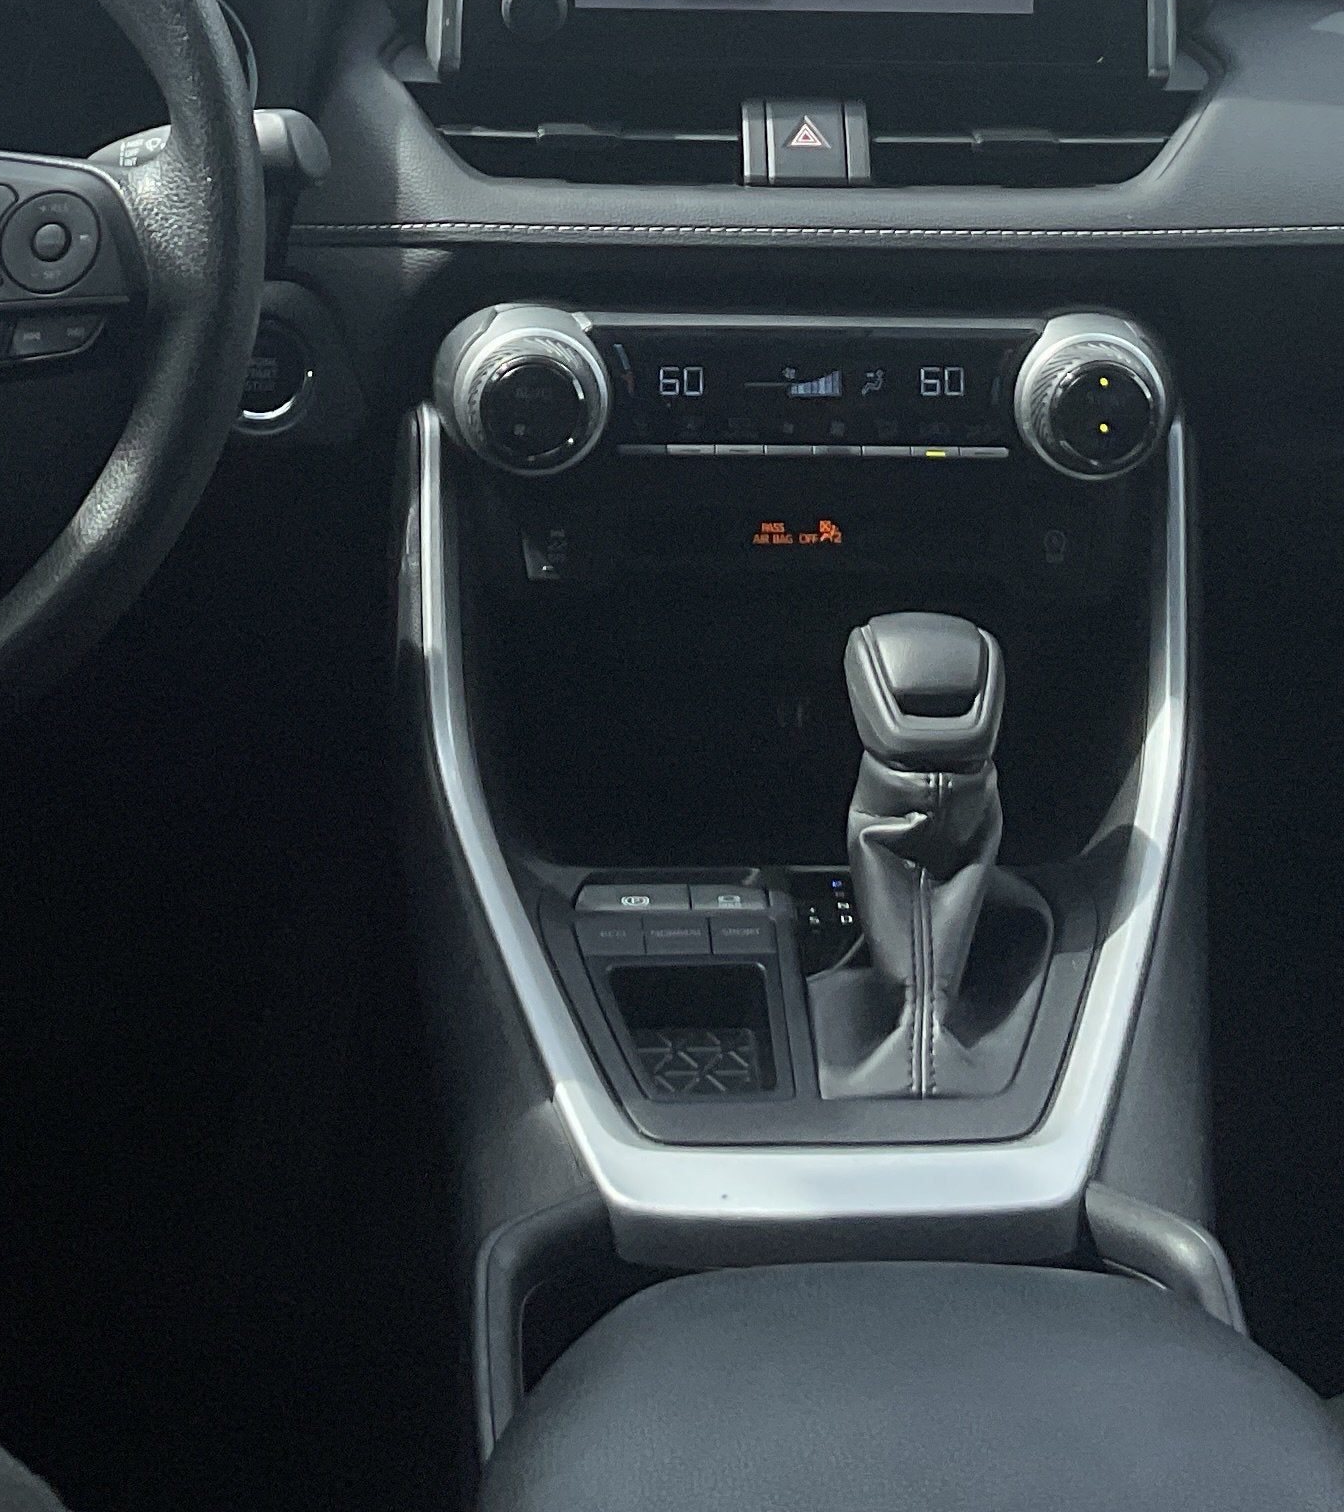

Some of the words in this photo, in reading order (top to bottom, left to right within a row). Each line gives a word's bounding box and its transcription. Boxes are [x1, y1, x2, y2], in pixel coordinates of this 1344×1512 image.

[658, 366, 704, 398] 60
[919, 366, 965, 398] 60
[761, 522, 785, 533] PASS
[752, 534, 769, 545] AIR
[772, 533, 794, 545] BAG
[798, 533, 818, 544] OFF
